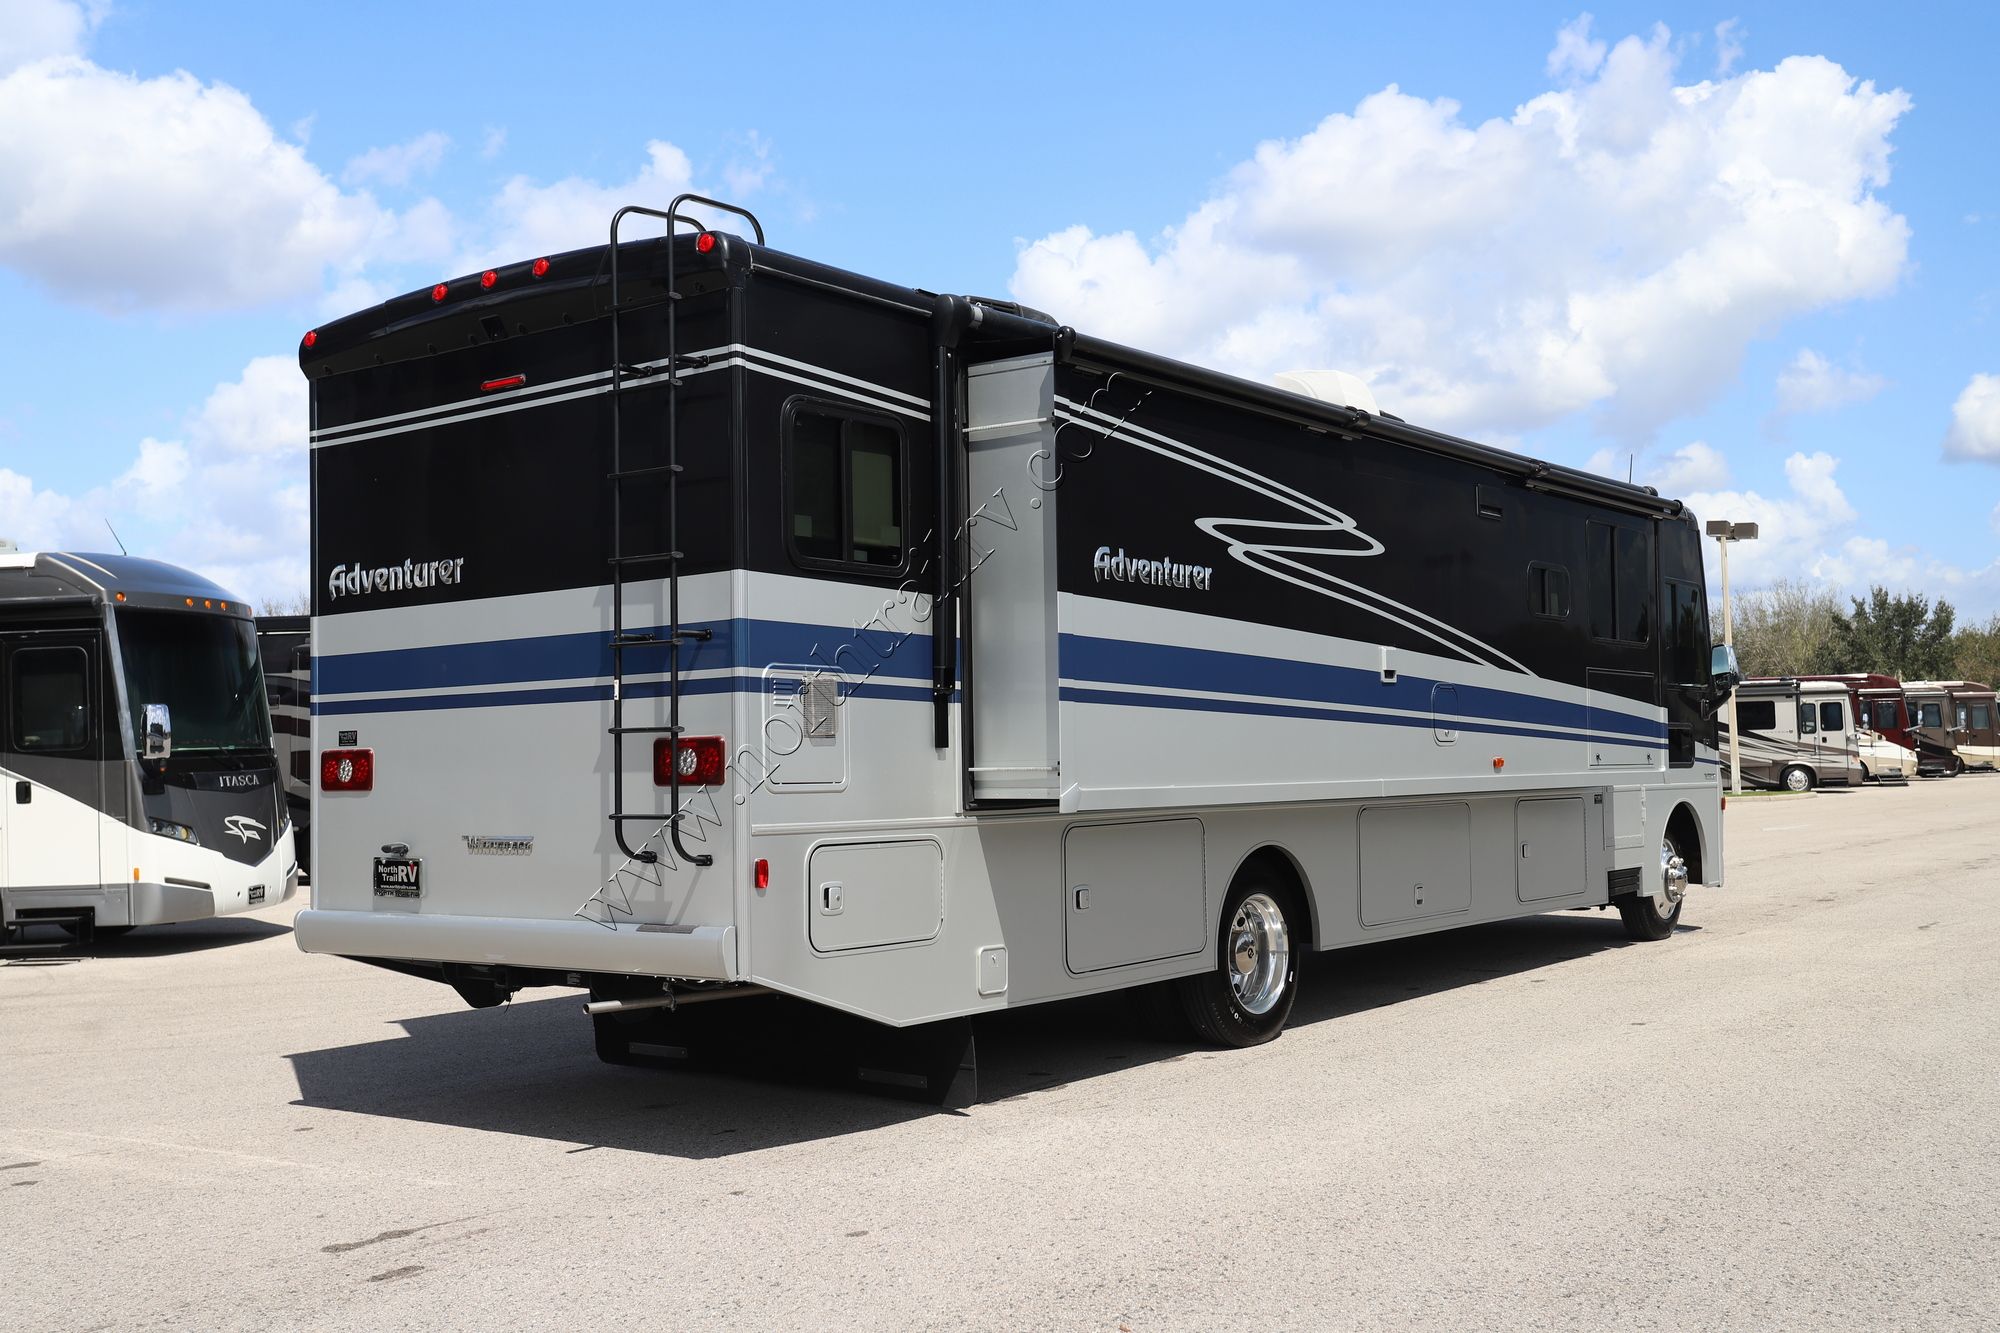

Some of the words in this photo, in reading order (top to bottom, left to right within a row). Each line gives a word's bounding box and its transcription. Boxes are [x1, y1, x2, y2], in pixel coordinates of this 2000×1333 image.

[1093, 546, 1213, 591] Adventurer
[328, 557, 464, 601] Adventurer
[219, 774, 260, 787] ITASCA
[378, 864, 398, 873] North
[397, 865, 418, 883] RV
[381, 873, 398, 882] Trail
